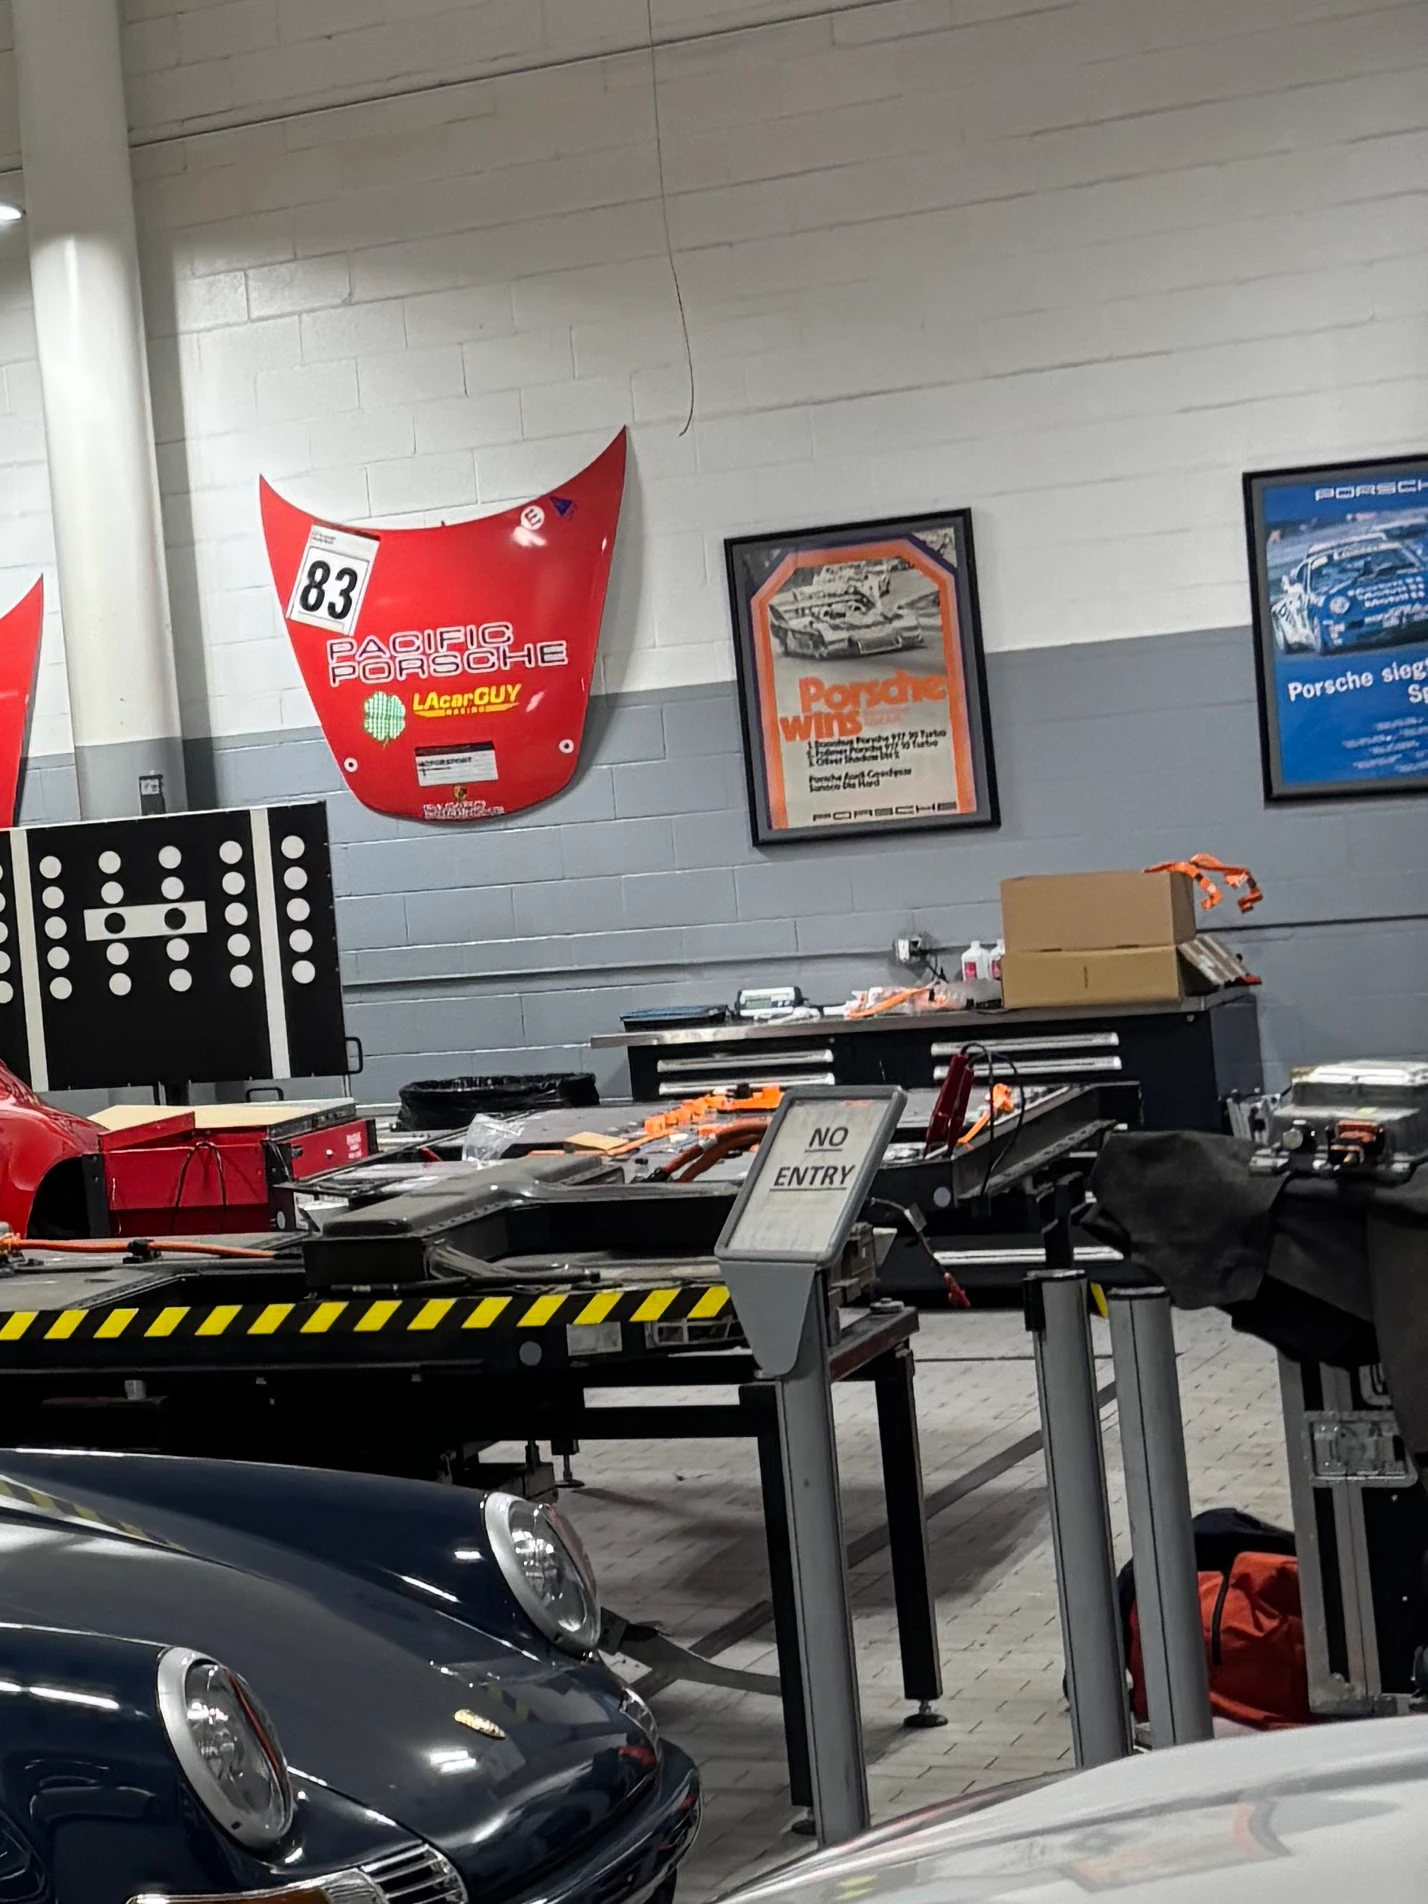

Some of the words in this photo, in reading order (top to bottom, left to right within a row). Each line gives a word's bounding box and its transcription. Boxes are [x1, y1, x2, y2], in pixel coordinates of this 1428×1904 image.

[299, 560, 358, 620] 83
[327, 622, 514, 663] PACIFIC
[329, 641, 568, 687] PORSCHE
[412, 683, 522, 711] LAcarGUY
[798, 667, 948, 713] Porsche
[1287, 671, 1374, 702] Porsche
[779, 710, 863, 743] wins
[812, 801, 958, 822] PORSCHE
[808, 1126, 849, 1148] NO
[773, 1164, 856, 1187] ENTRY
